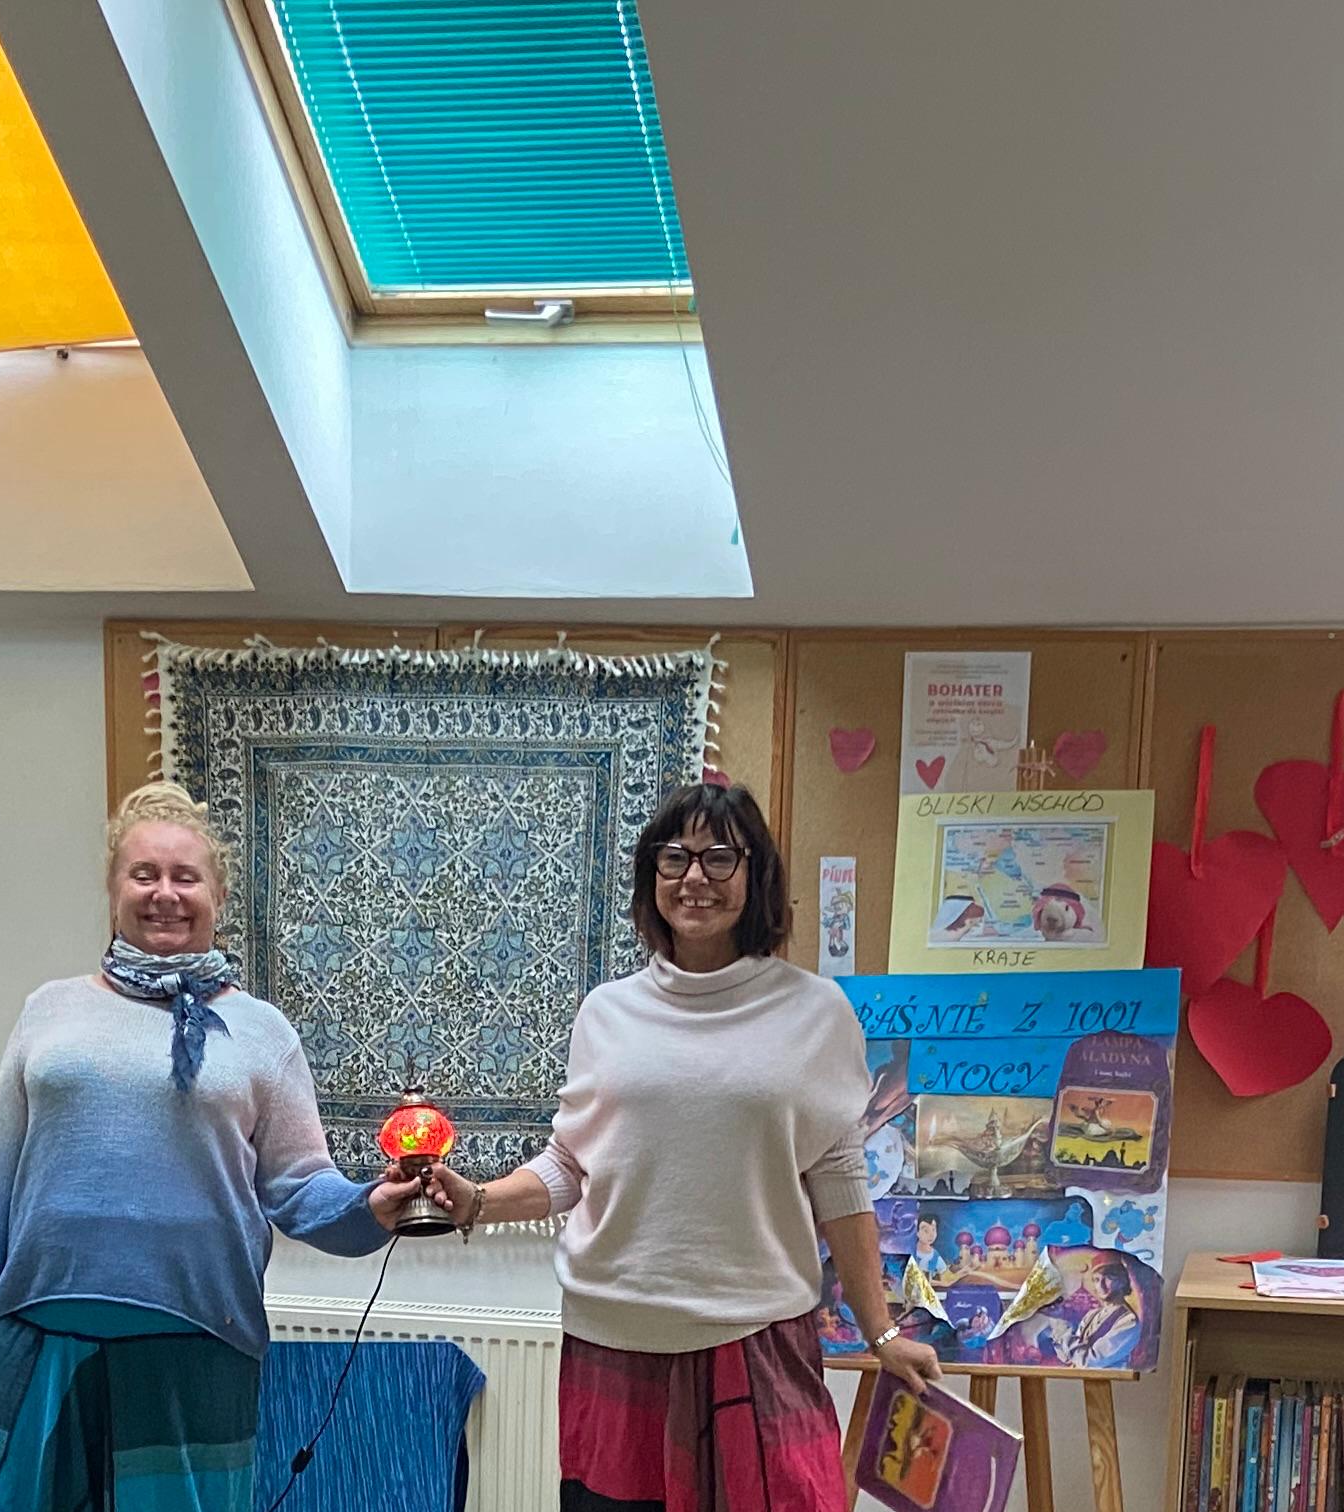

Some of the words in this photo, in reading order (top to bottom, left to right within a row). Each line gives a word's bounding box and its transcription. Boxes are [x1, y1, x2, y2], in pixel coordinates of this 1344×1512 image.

[927, 683, 1004, 698] BOHATER
[917, 795, 993, 817] BLISKI
[1011, 792, 1104, 813] WSCHÓD
[973, 951, 1037, 967] KRAJE
[1012, 1003, 1044, 1033] Z
[1062, 1000, 1143, 1034] 1001
[1080, 1050, 1151, 1065] ALADYNA
[923, 1061, 1052, 1094] NOCY
